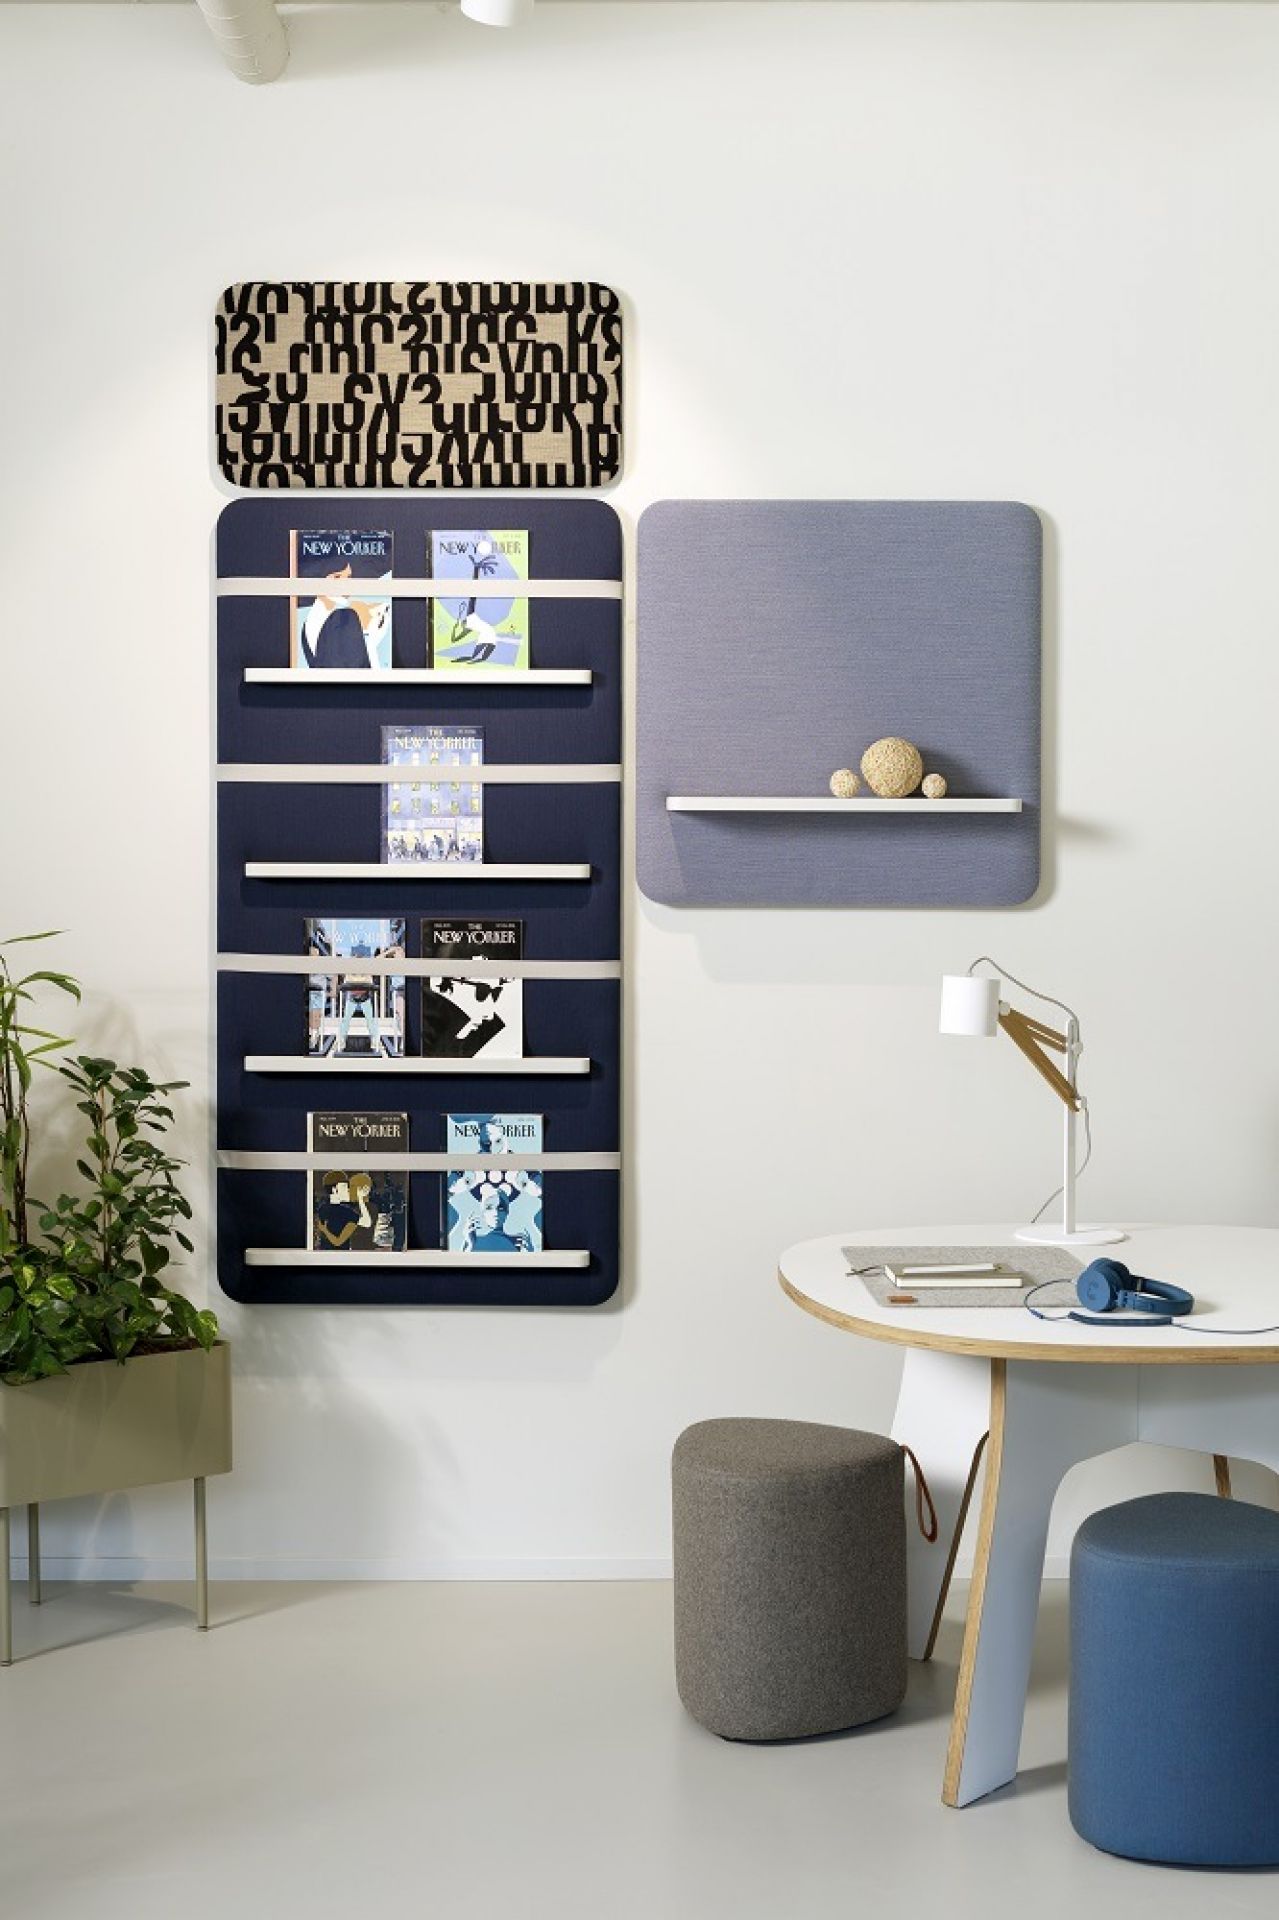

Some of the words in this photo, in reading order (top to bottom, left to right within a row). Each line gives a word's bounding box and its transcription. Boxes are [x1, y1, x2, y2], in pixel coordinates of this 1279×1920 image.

[303, 541, 333, 555] NEW
[334, 541, 386, 555] YORKER
[440, 541, 469, 555] NEW
[470, 541, 521, 554] YRKER
[395, 737, 424, 749] NEW
[434, 931, 463, 943] NEW
[464, 931, 515, 944] YORKER
[320, 1125, 348, 1137] NEW
[351, 1125, 400, 1137] YORKER
[455, 1125, 481, 1137] NEW
